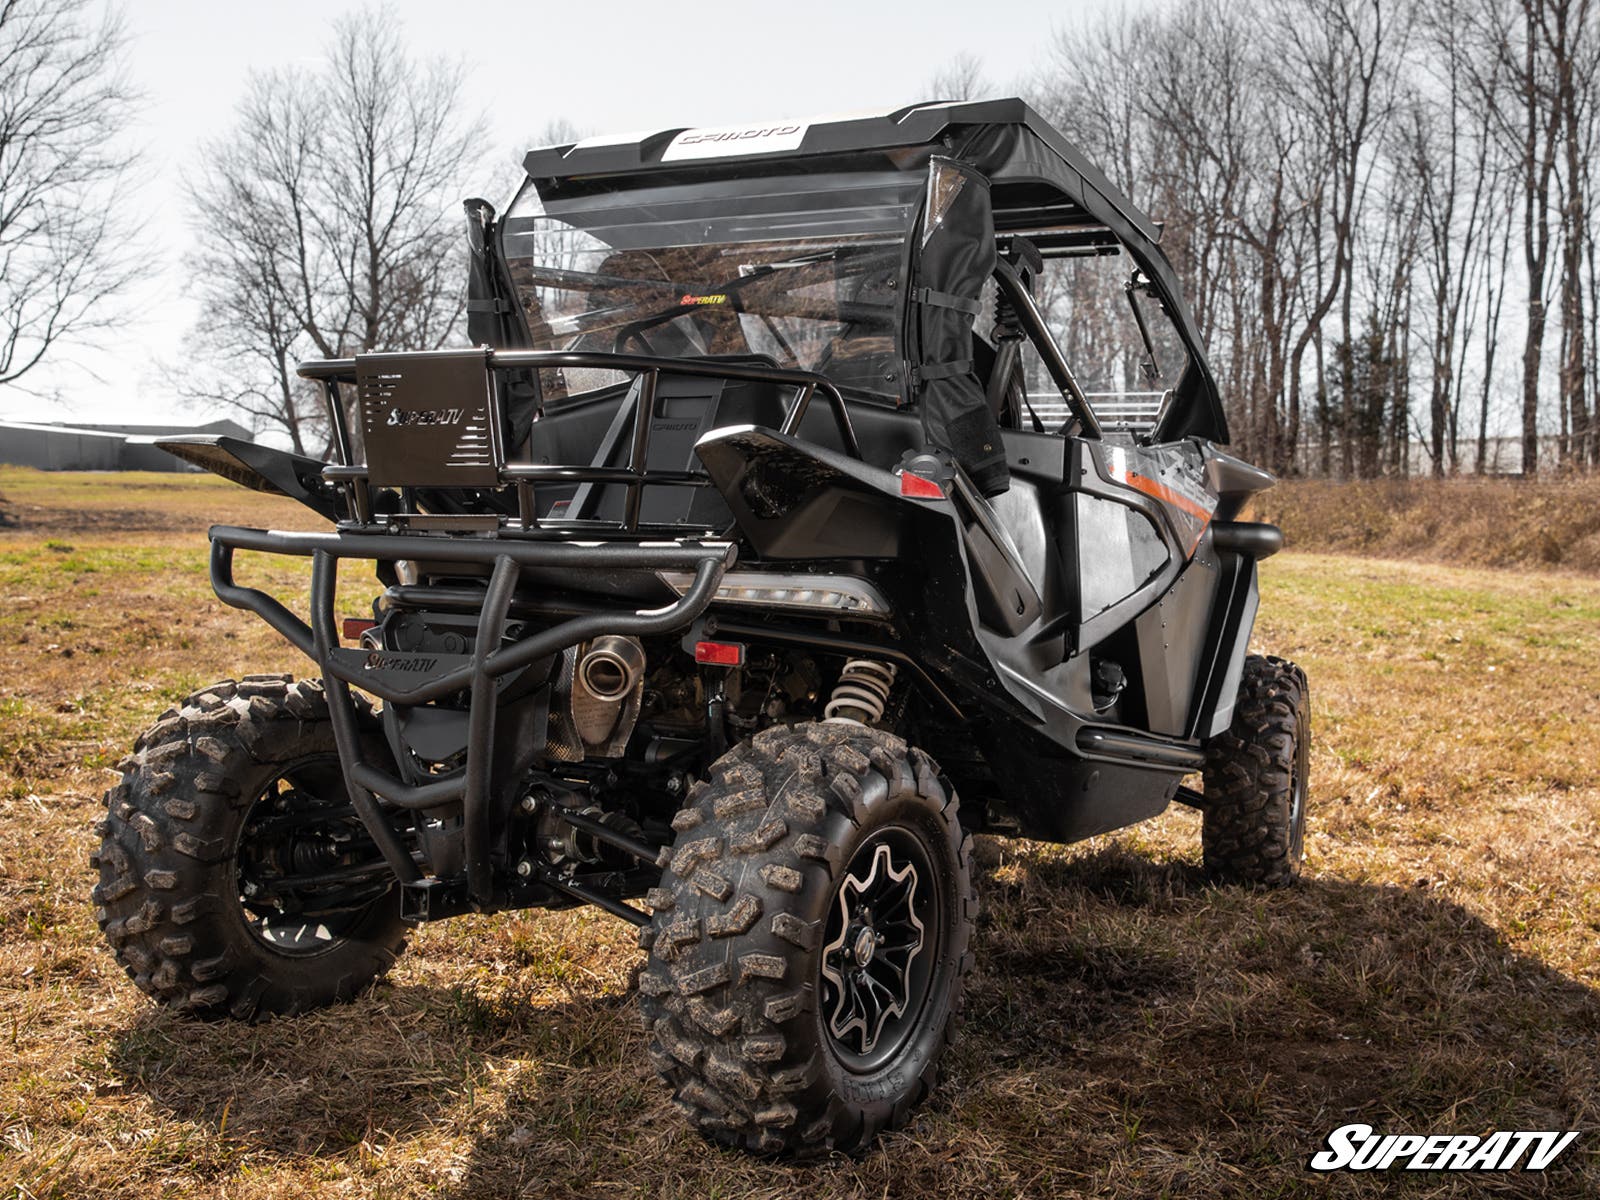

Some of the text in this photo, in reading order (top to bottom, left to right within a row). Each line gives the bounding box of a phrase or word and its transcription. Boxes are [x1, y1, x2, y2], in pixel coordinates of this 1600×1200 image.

[678, 126, 801, 145] CFMOTO
[680, 294, 727, 305] SUPERATV
[386, 408, 465, 426] SUPERATV
[363, 652, 438, 672] SUPERATV
